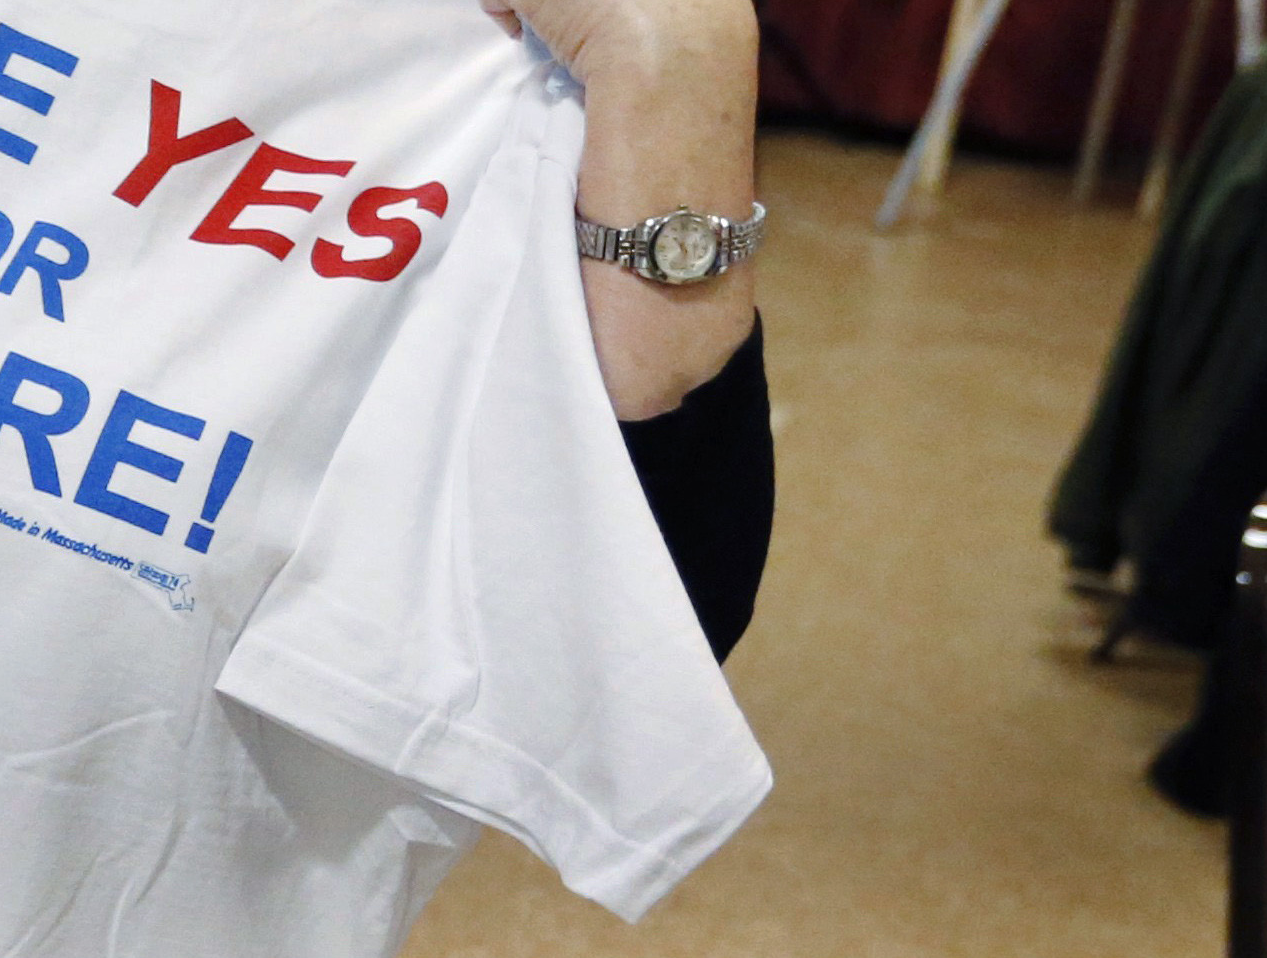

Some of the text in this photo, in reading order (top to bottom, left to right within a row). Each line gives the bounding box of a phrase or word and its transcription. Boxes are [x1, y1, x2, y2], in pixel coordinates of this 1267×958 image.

[113, 79, 449, 282] YES
[27, 521, 40, 537] in
[41, 527, 134, 571] Massachusetts
